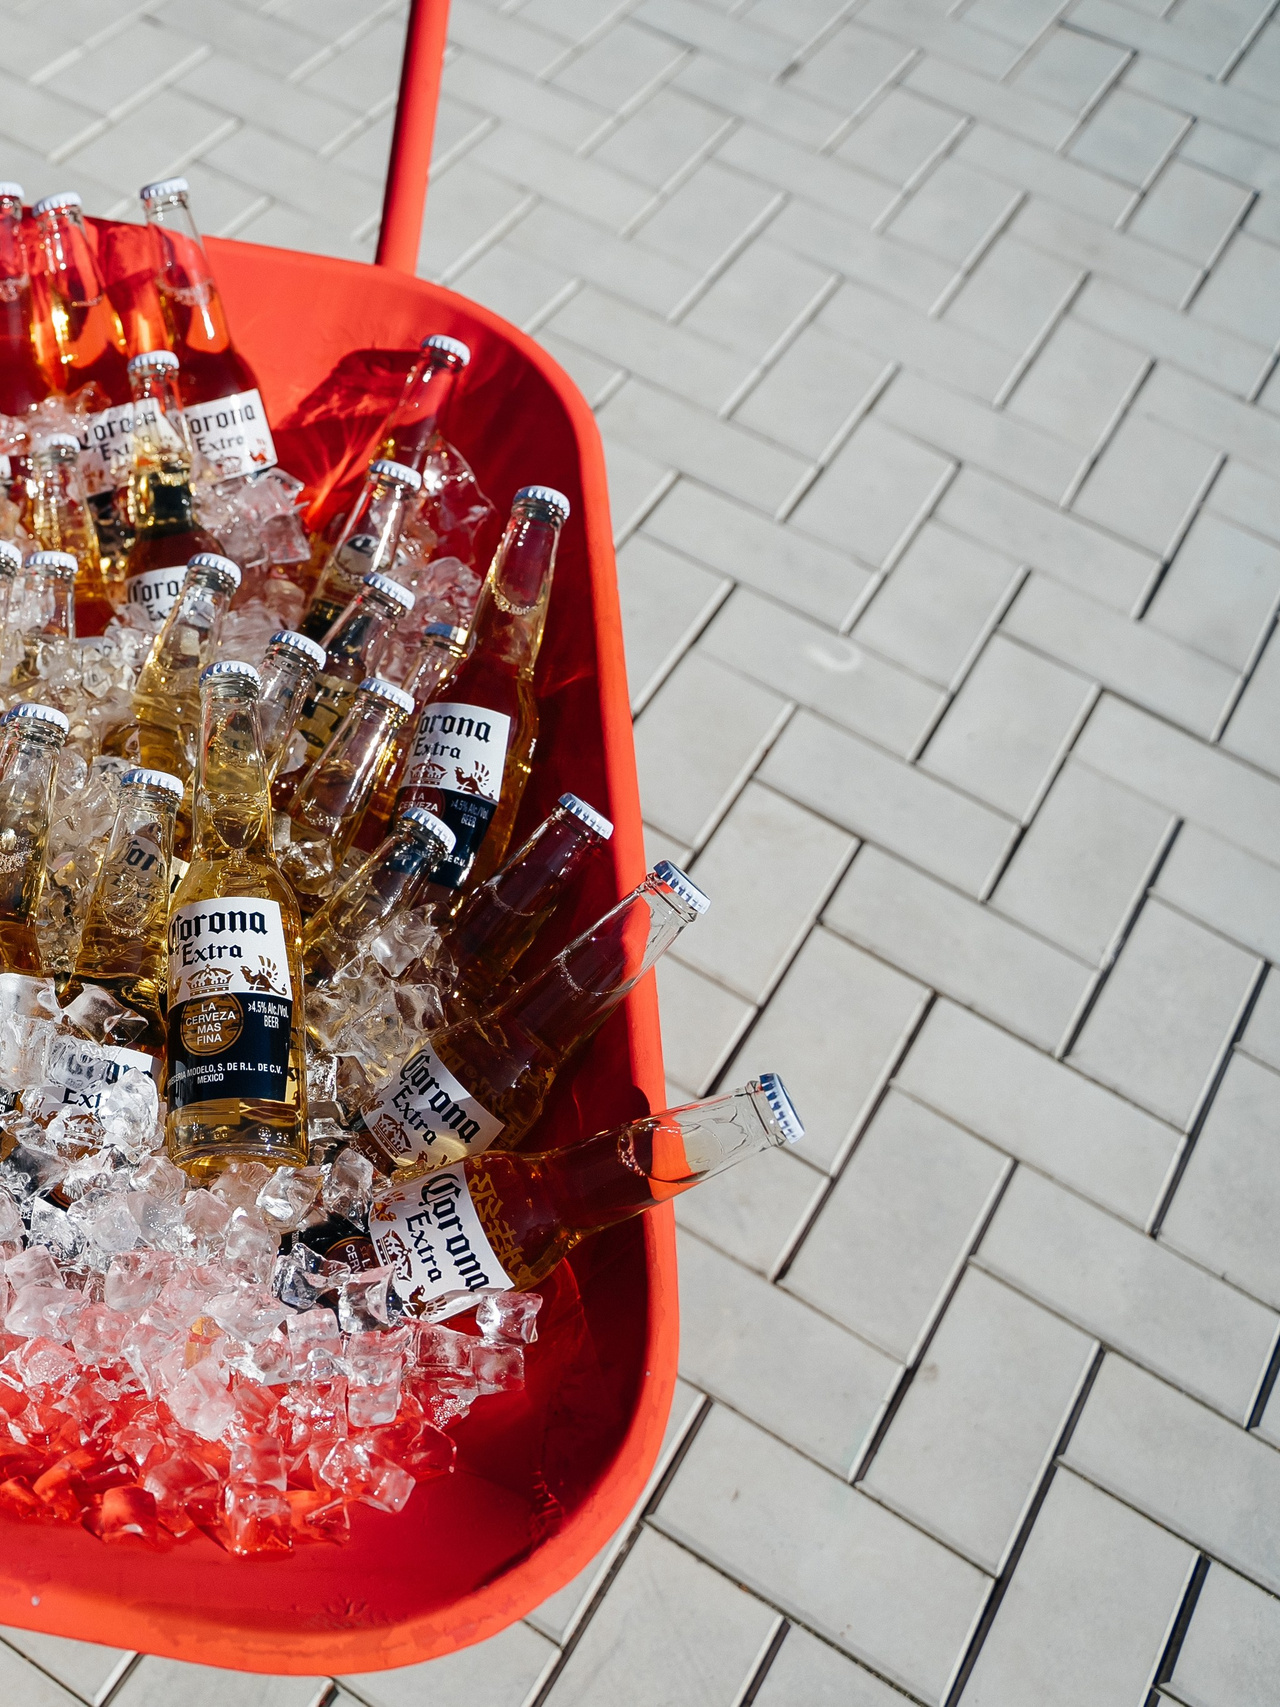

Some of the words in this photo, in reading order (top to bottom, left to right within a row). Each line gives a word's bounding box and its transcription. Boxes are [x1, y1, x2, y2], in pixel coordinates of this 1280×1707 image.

[184, 404, 256, 435] orona
[99, 442, 131, 461] Ext
[127, 579, 186, 606] Coro
[418, 711, 492, 743] orona
[413, 737, 461, 760] Extra
[460, 813, 477, 828] BEER
[181, 941, 243, 967] Extra
[186, 1010, 236, 1027] CERVEZA
[201, 1003, 217, 1012] LA
[197, 1022, 222, 1034] MAS
[264, 1015, 280, 1029] BEER
[196, 1034, 222, 1046] FINA
[187, 1064, 216, 1078] MODELO,
[217, 1063, 225, 1072] S.
[227, 1062, 238, 1071] DE
[239, 1062, 256, 1071] R.L.
[257, 1063, 268, 1072] DE
[269, 1064, 283, 1075] C.V.
[197, 1073, 224, 1085] MEXICO
[61, 1088, 103, 1109] Ext
[399, 1049, 481, 1144] Corona
[391, 1084, 437, 1146] Extra
[421, 1172, 489, 1292] Corona
[405, 1210, 443, 1283] Extra
[345, 1244, 361, 1274] CERV
